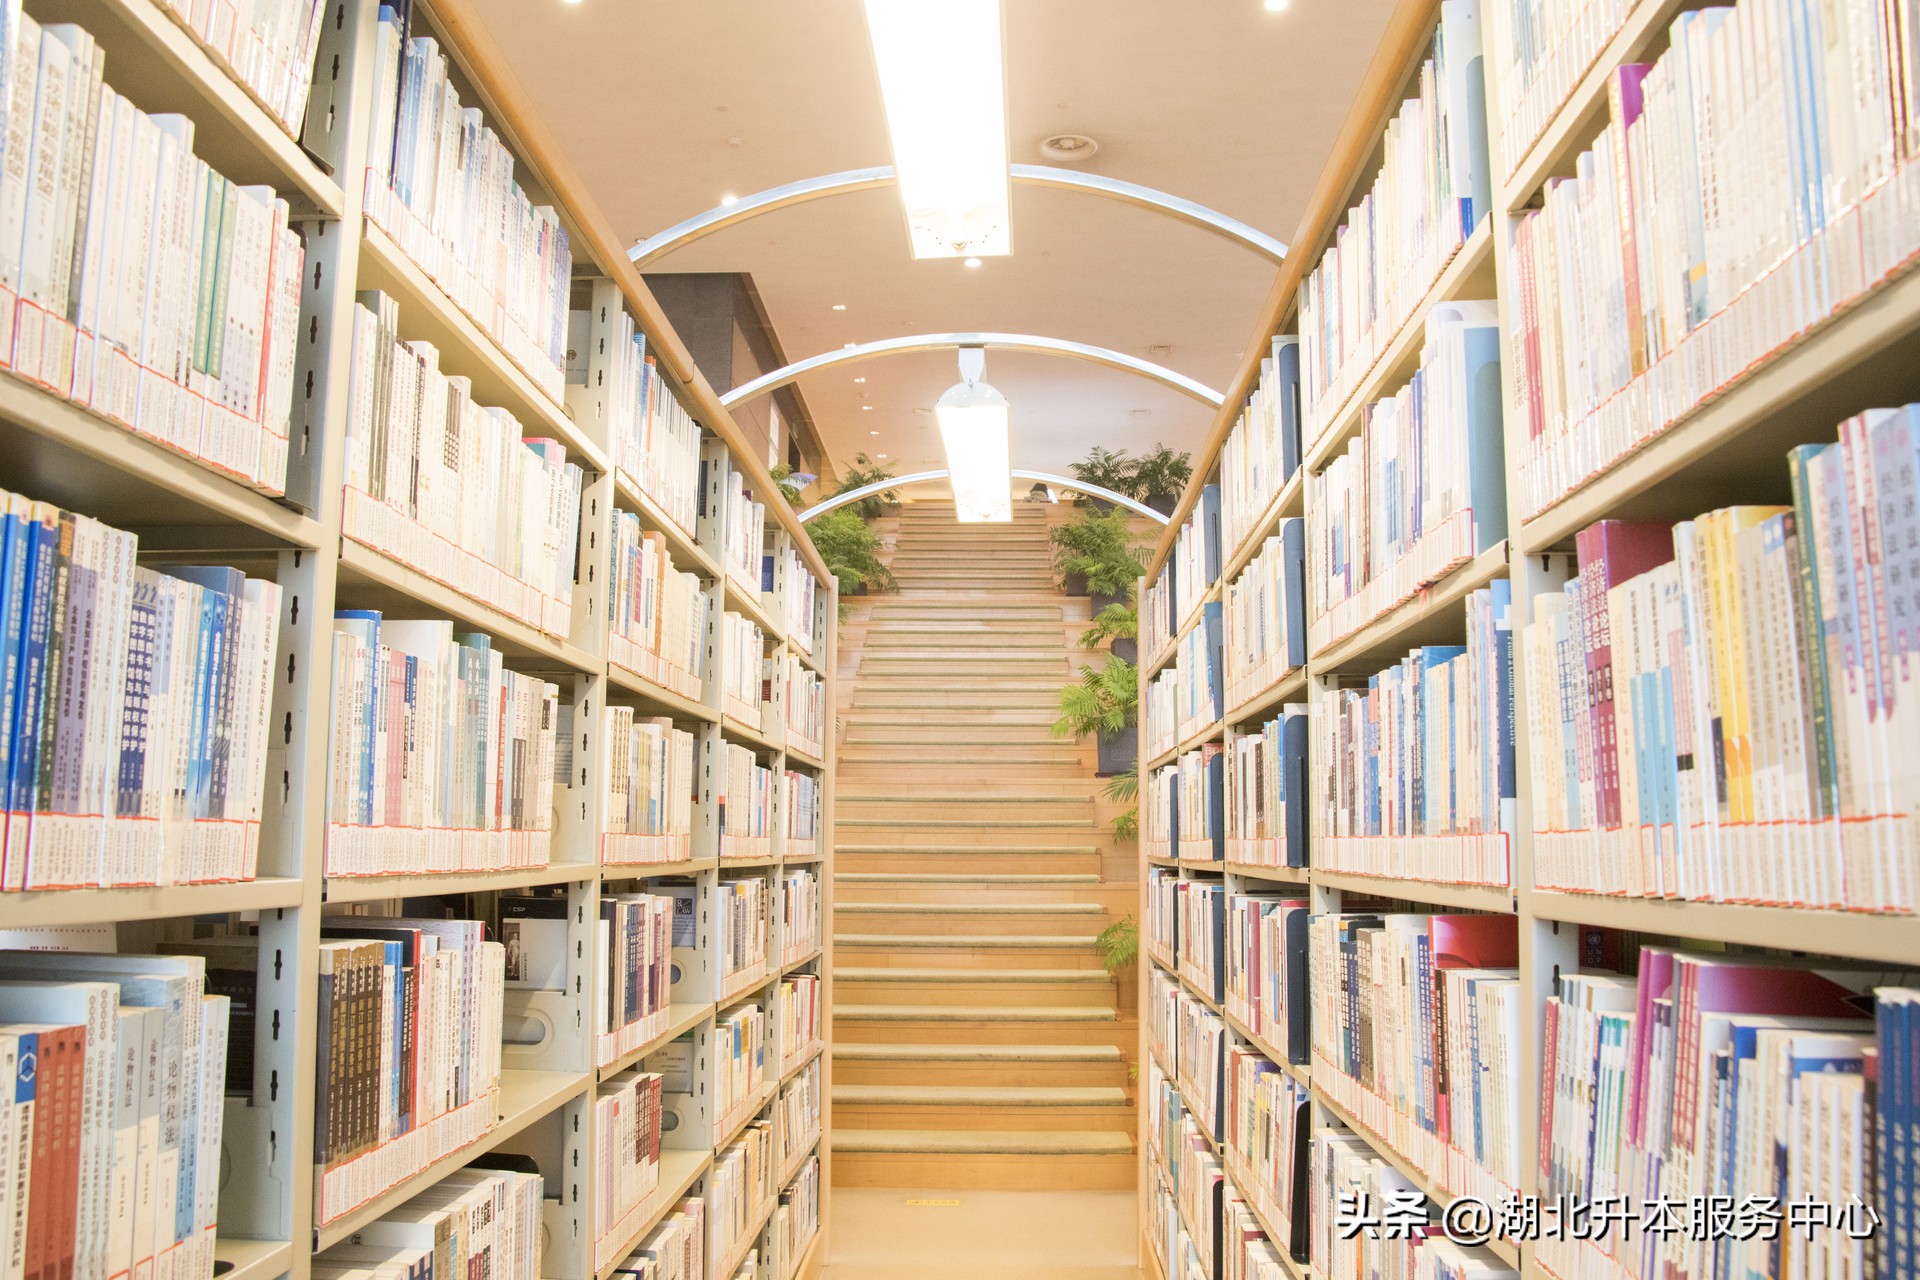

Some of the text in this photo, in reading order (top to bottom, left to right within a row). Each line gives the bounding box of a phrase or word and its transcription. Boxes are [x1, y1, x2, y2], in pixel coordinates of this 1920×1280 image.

[1579, 567, 1593, 653] 经济法论坛
[1588, 562, 1602, 650] 经济法论坛
[1596, 558, 1611, 647] 经济法论坛
[121, 609, 139, 752] 数字图书馆与版权保护
[130, 610, 147, 752] 数字图书馆与版权保护
[139, 613, 156, 753] 数字图书馆与版权保护
[124, 1047, 135, 1108] 论物权法
[147, 1038, 158, 1098] 论物权法
[164, 1060, 178, 1145] 论物权法
